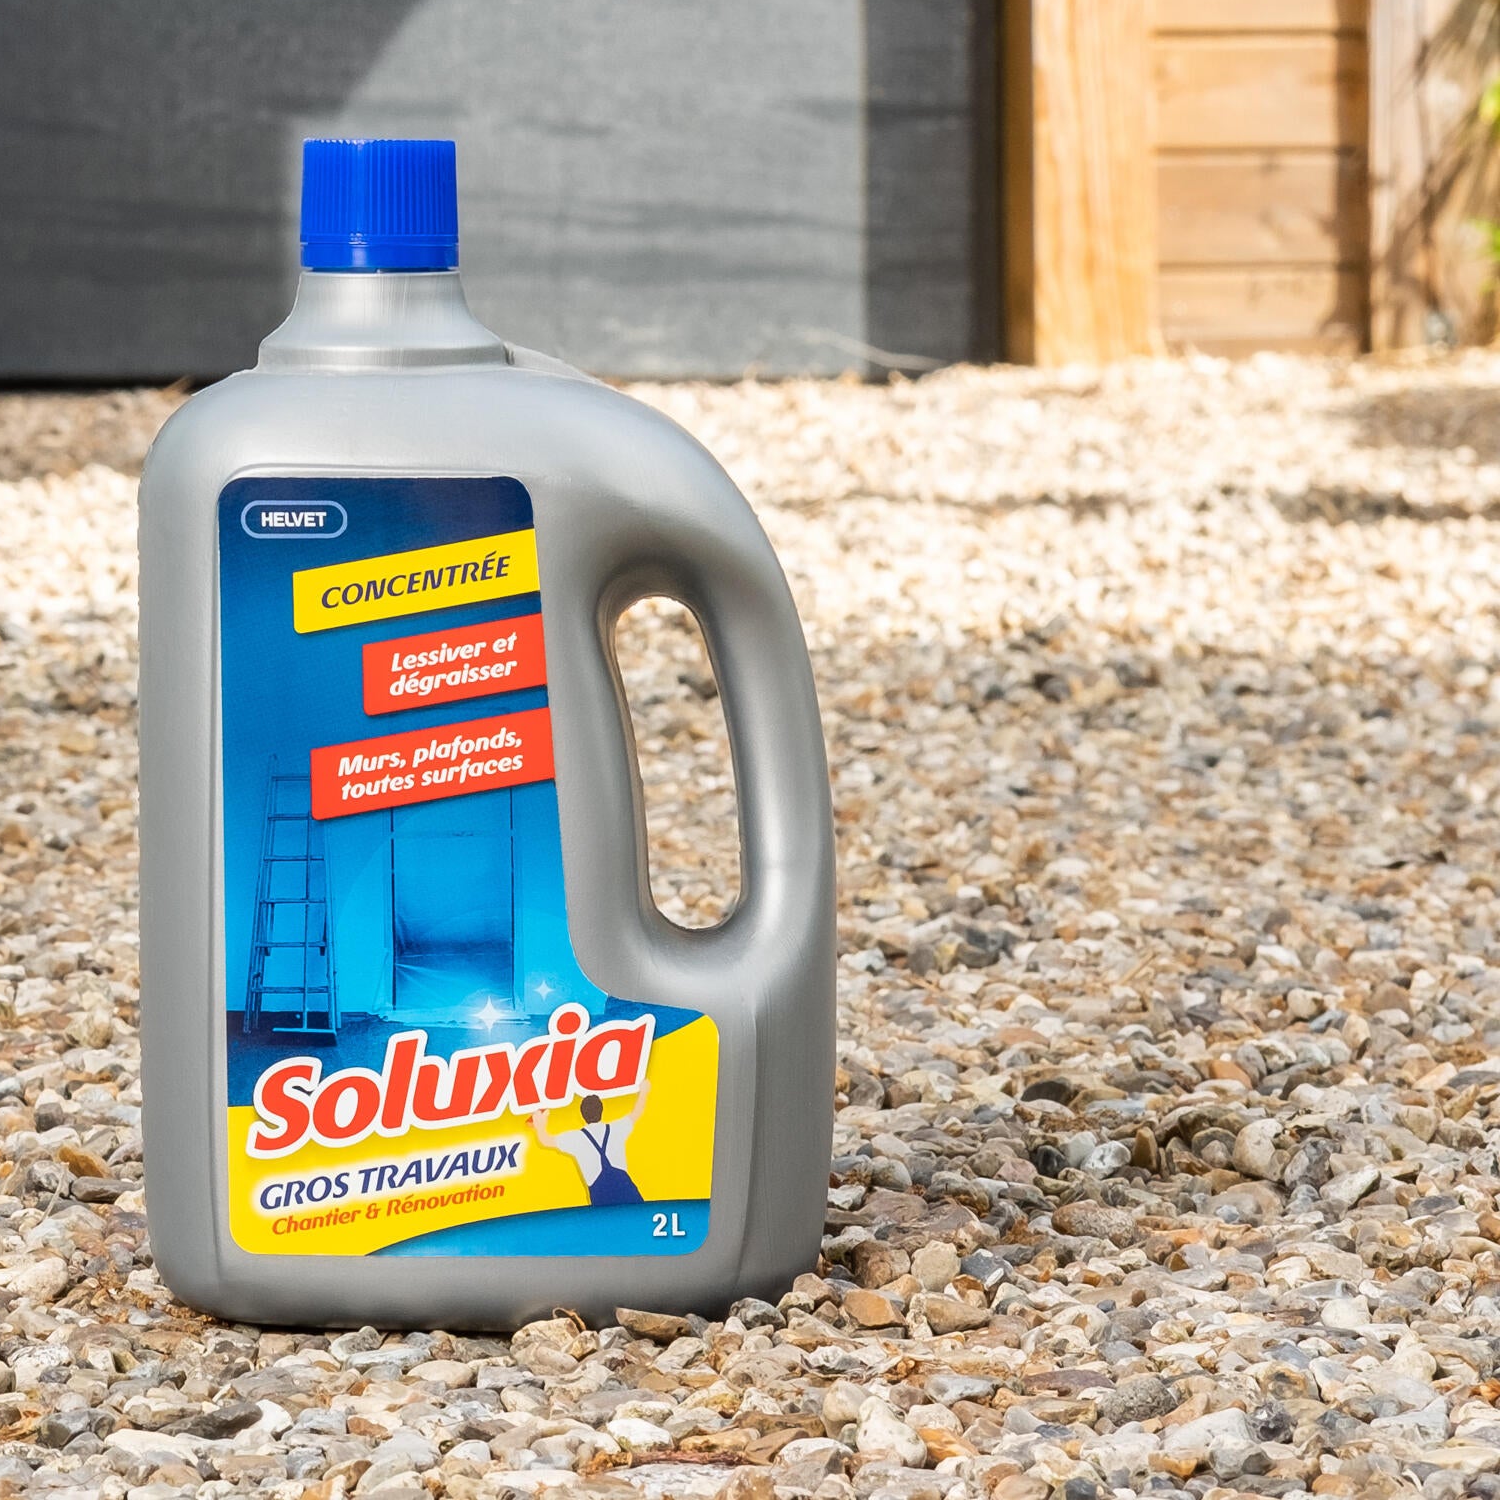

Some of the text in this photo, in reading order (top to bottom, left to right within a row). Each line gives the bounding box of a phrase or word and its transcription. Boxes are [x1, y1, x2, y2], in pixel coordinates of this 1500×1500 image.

[261, 512, 327, 527] HELVET
[321, 551, 511, 609] CONCENTRÉE
[391, 632, 518, 672] Lessiver et
[389, 659, 518, 696] dégraisser
[338, 727, 523, 777] Murs, plafonds,
[341, 754, 523, 801] toutes surfaces
[254, 1010, 647, 1150] Soluxia
[259, 1141, 522, 1211] GROS TRAVAUX
[272, 1182, 506, 1236] Chantier & Rénovation
